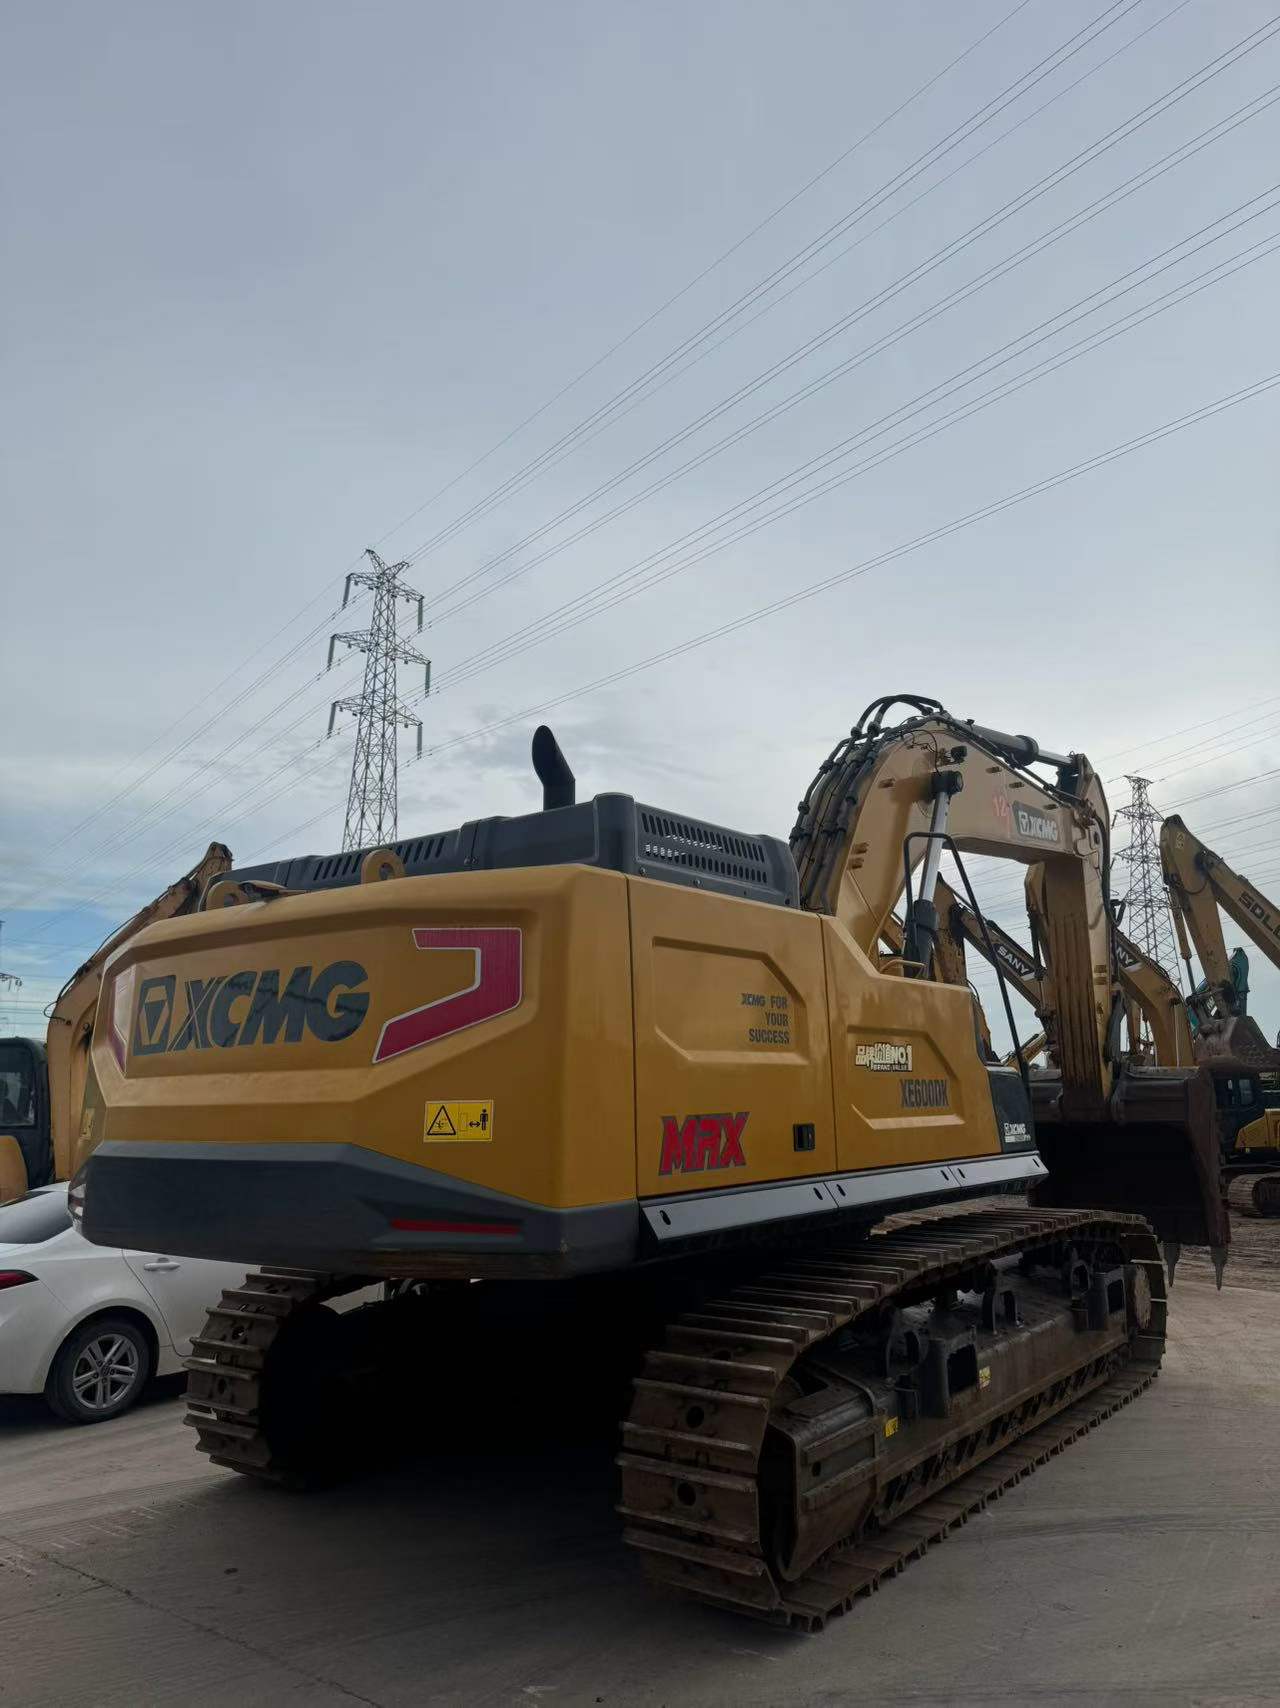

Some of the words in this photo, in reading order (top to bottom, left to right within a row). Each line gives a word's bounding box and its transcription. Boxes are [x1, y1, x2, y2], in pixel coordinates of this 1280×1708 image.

[1030, 815, 1057, 841] XCMG
[997, 945, 1030, 974] SANY
[167, 960, 370, 1052] XCMG
[741, 993, 766, 1007] XCMG
[770, 995, 788, 1009] FOR
[765, 1011, 789, 1026] YOUR
[748, 1028, 790, 1044] SUCCESS
